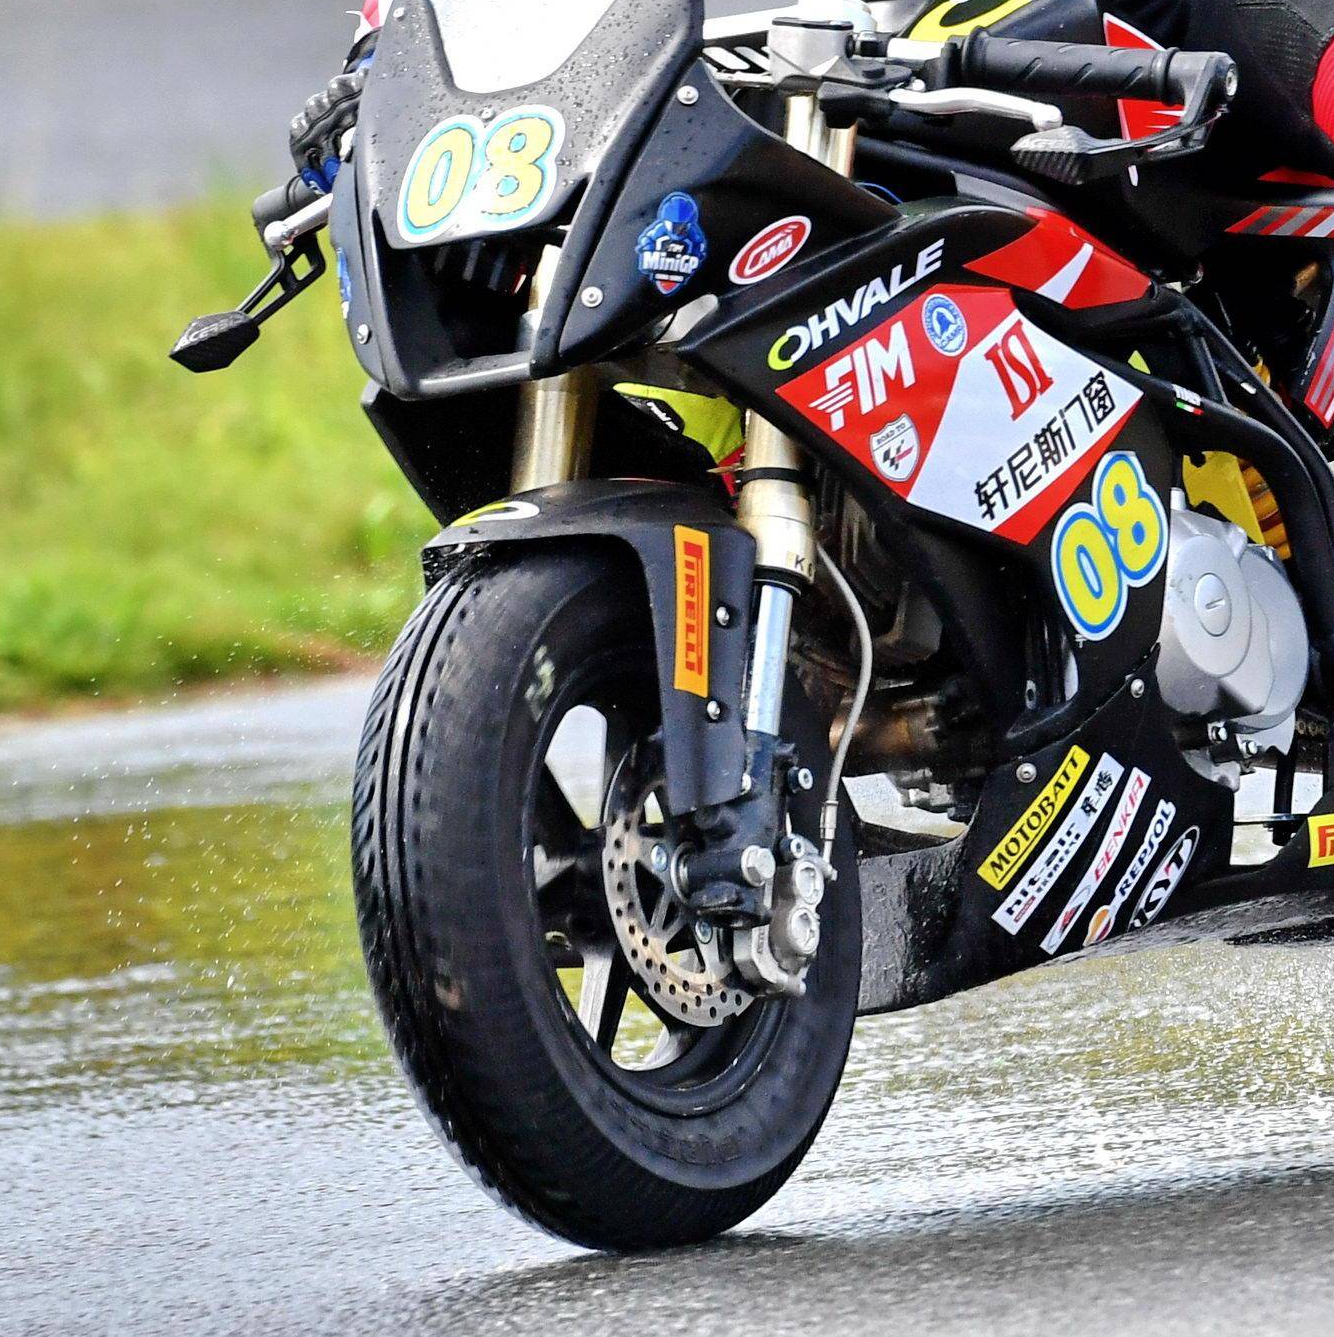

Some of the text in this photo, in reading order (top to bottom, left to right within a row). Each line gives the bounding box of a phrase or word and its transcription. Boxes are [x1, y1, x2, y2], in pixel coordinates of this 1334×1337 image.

[401, 110, 559, 234] 08
[642, 251, 700, 274] MiniGP
[768, 238, 945, 371] OHVALE
[808, 320, 916, 432] FIM
[973, 370, 1116, 521] 轩尼斯门窗
[683, 540, 703, 676] PIRELLI
[1054, 453, 1165, 636] 08
[989, 751, 1078, 879] MOTOBATT
[1119, 809, 1172, 897] REPSOL
